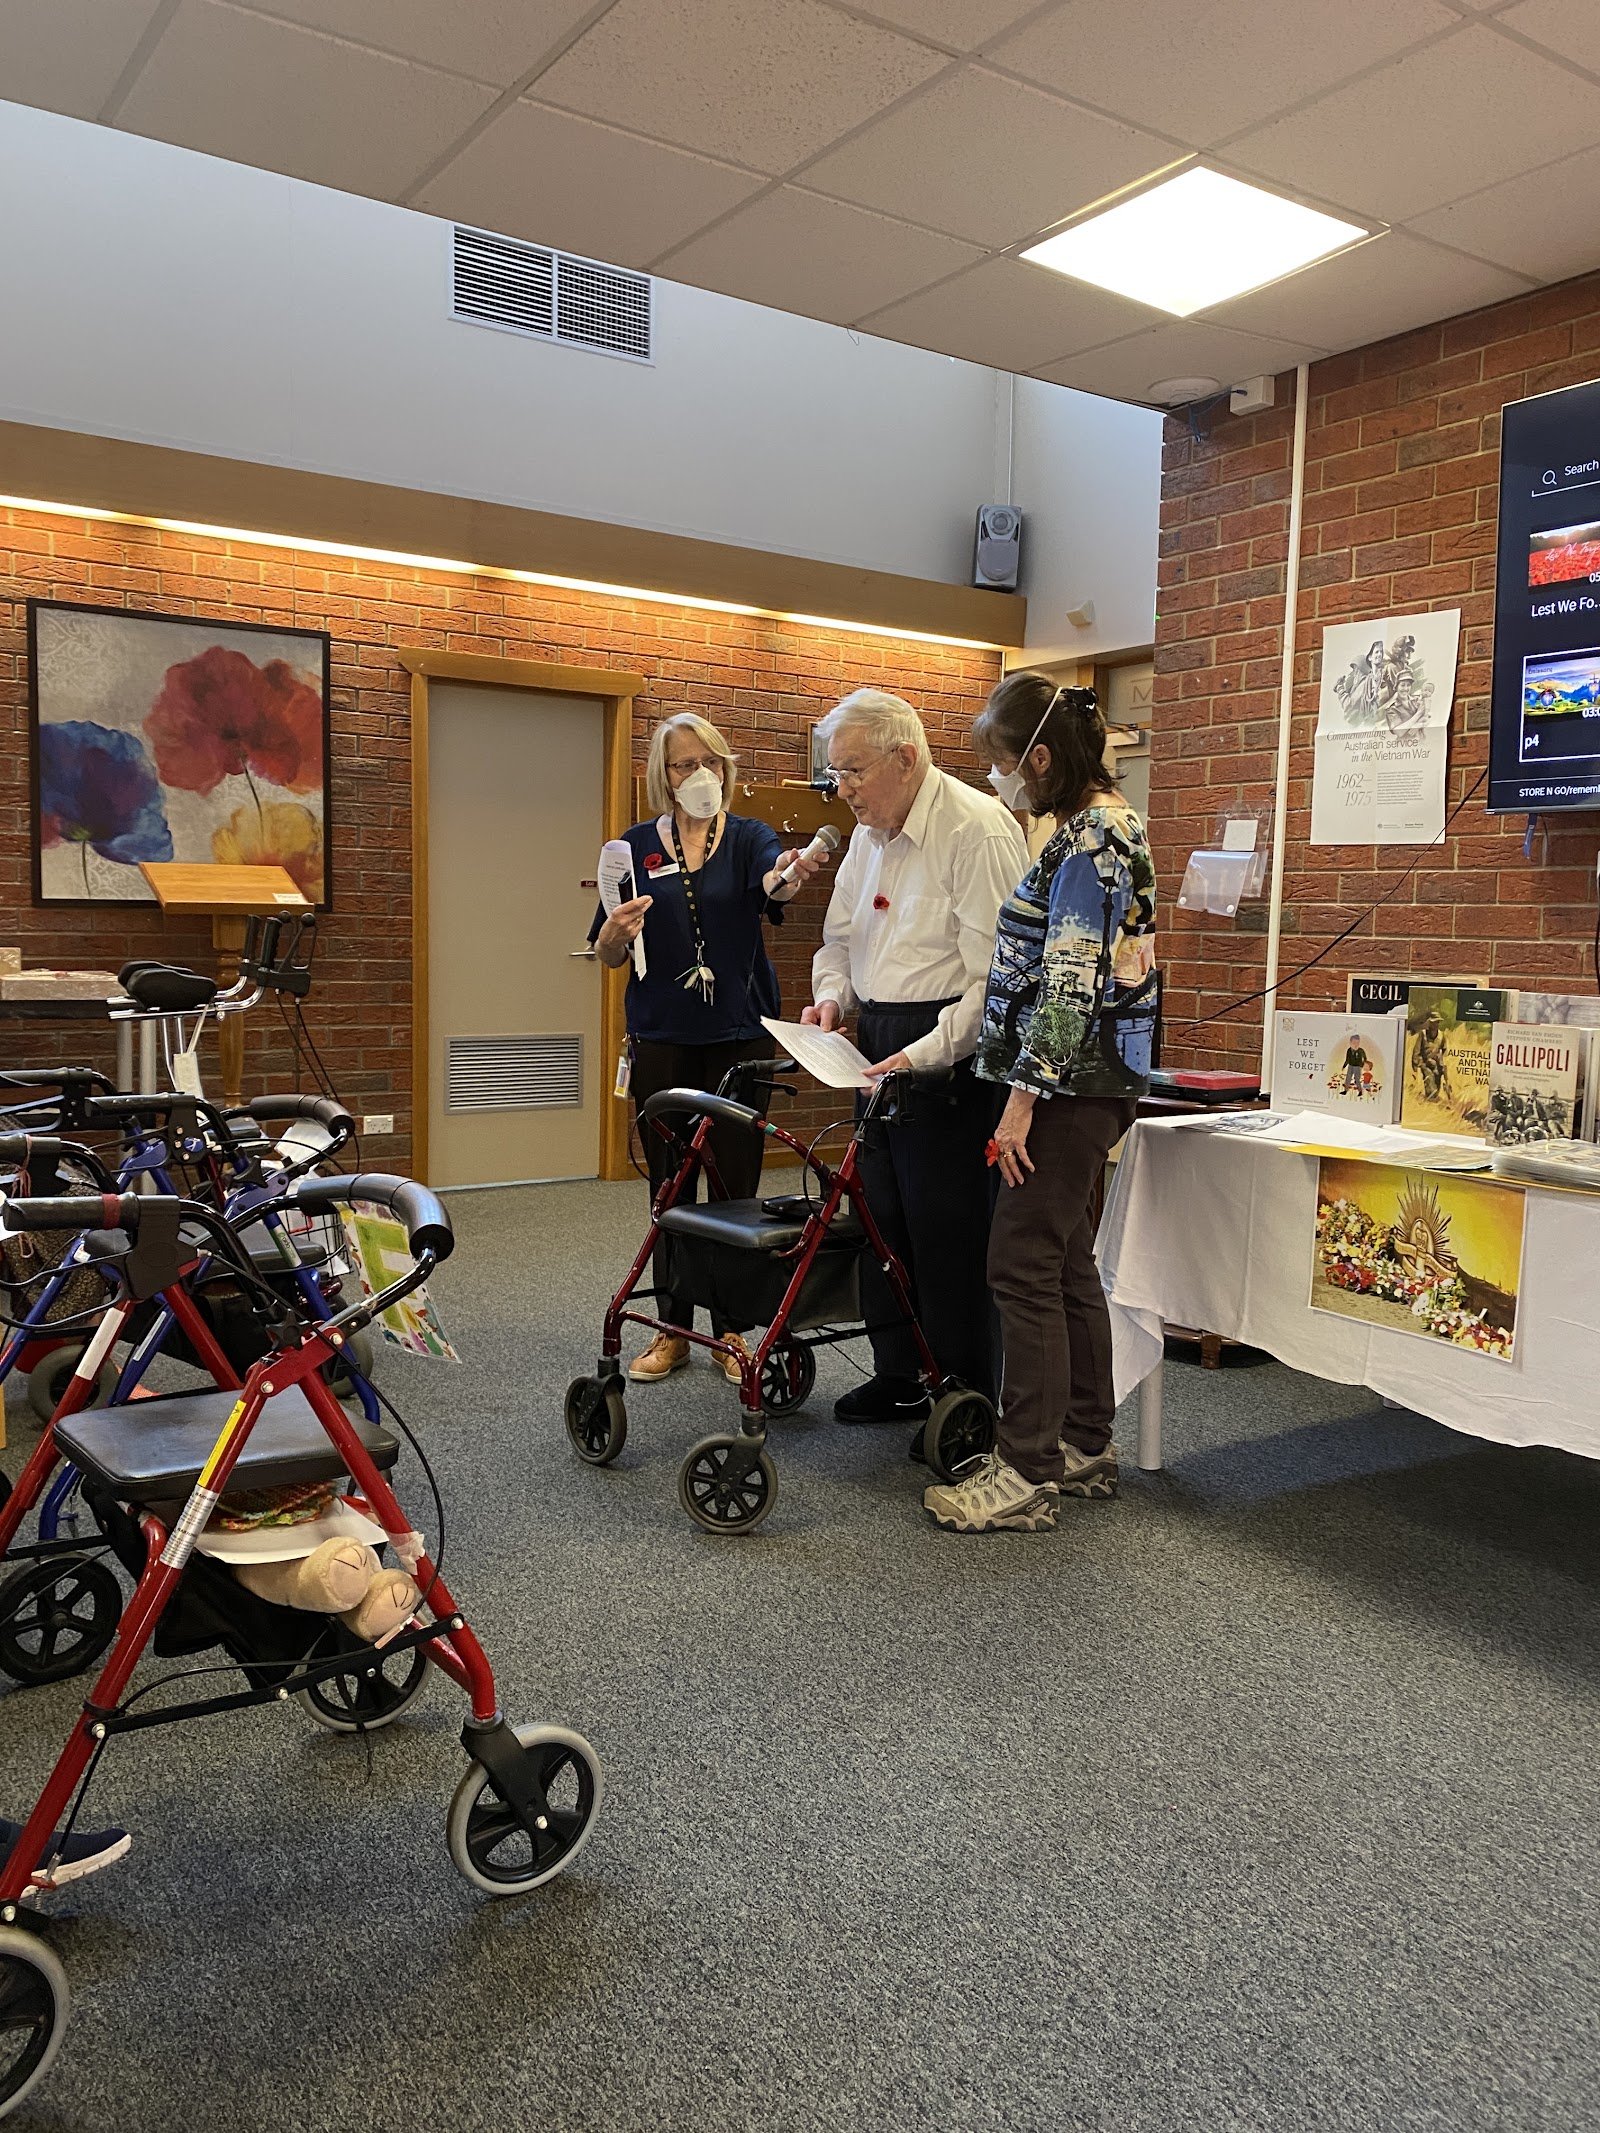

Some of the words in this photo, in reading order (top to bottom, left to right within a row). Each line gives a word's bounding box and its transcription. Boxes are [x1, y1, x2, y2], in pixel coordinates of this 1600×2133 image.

[1564, 459, 1600, 476] Search
[1531, 602, 1556, 617] Lest
[1557, 598, 1577, 613] We
[1326, 730, 1386, 741] Commemorating
[1344, 740, 1384, 751] Australian
[1386, 738, 1419, 748] service
[1524, 734, 1540, 750] p4
[1351, 752, 1359, 762] in
[1361, 751, 1373, 762] the
[1374, 750, 1411, 760] Vietnam
[1412, 749, 1431, 759] War
[1519, 787, 1545, 797] STORE
[1546, 787, 1553, 796] N
[1344, 791, 1373, 806] 1975
[1359, 983, 1402, 1000] CECIL
[1297, 1038, 1320, 1047] LEST
[1300, 1050, 1315, 1059] WE
[1447, 1049, 1490, 1059] AUSTRALI
[1496, 1043, 1570, 1072] GALLIPOLI
[1288, 1061, 1326, 1072] FORGET
[1458, 1058, 1478, 1067] AND
[1478, 1060, 1490, 1069] TH
[1456, 1067, 1490, 1077] VIETNA
[1475, 1077, 1489, 1085] WA
